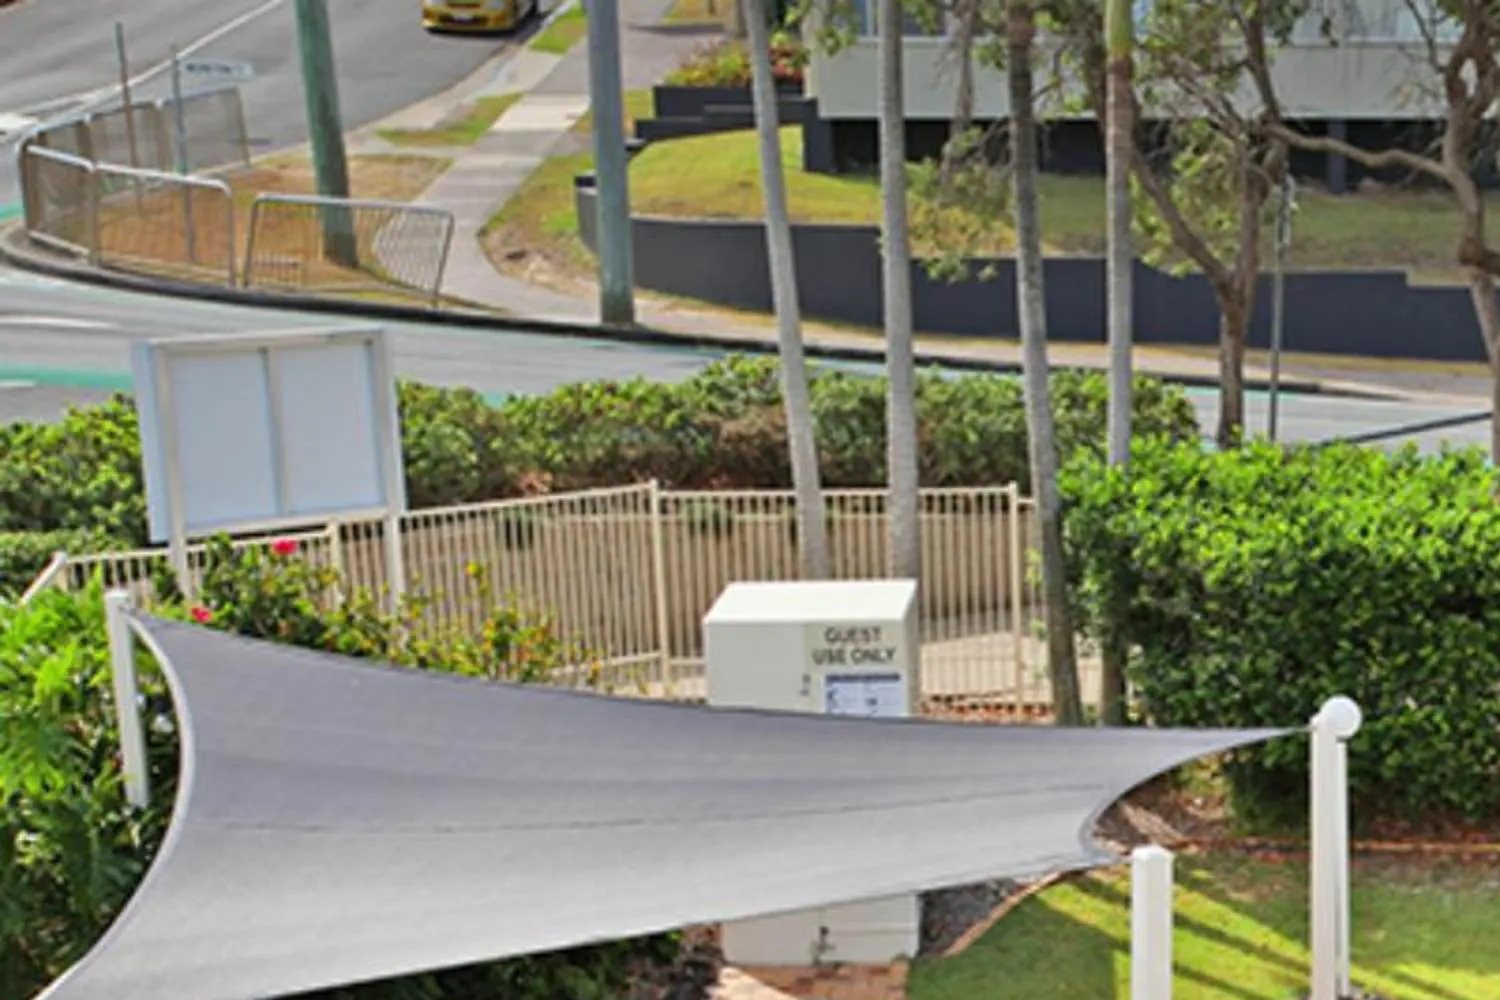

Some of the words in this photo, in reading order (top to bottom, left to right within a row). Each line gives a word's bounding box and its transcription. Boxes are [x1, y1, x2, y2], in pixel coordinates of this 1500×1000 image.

[824, 626, 881, 643] GUEST
[812, 647, 846, 665] USE
[850, 646, 897, 665] ONLY
